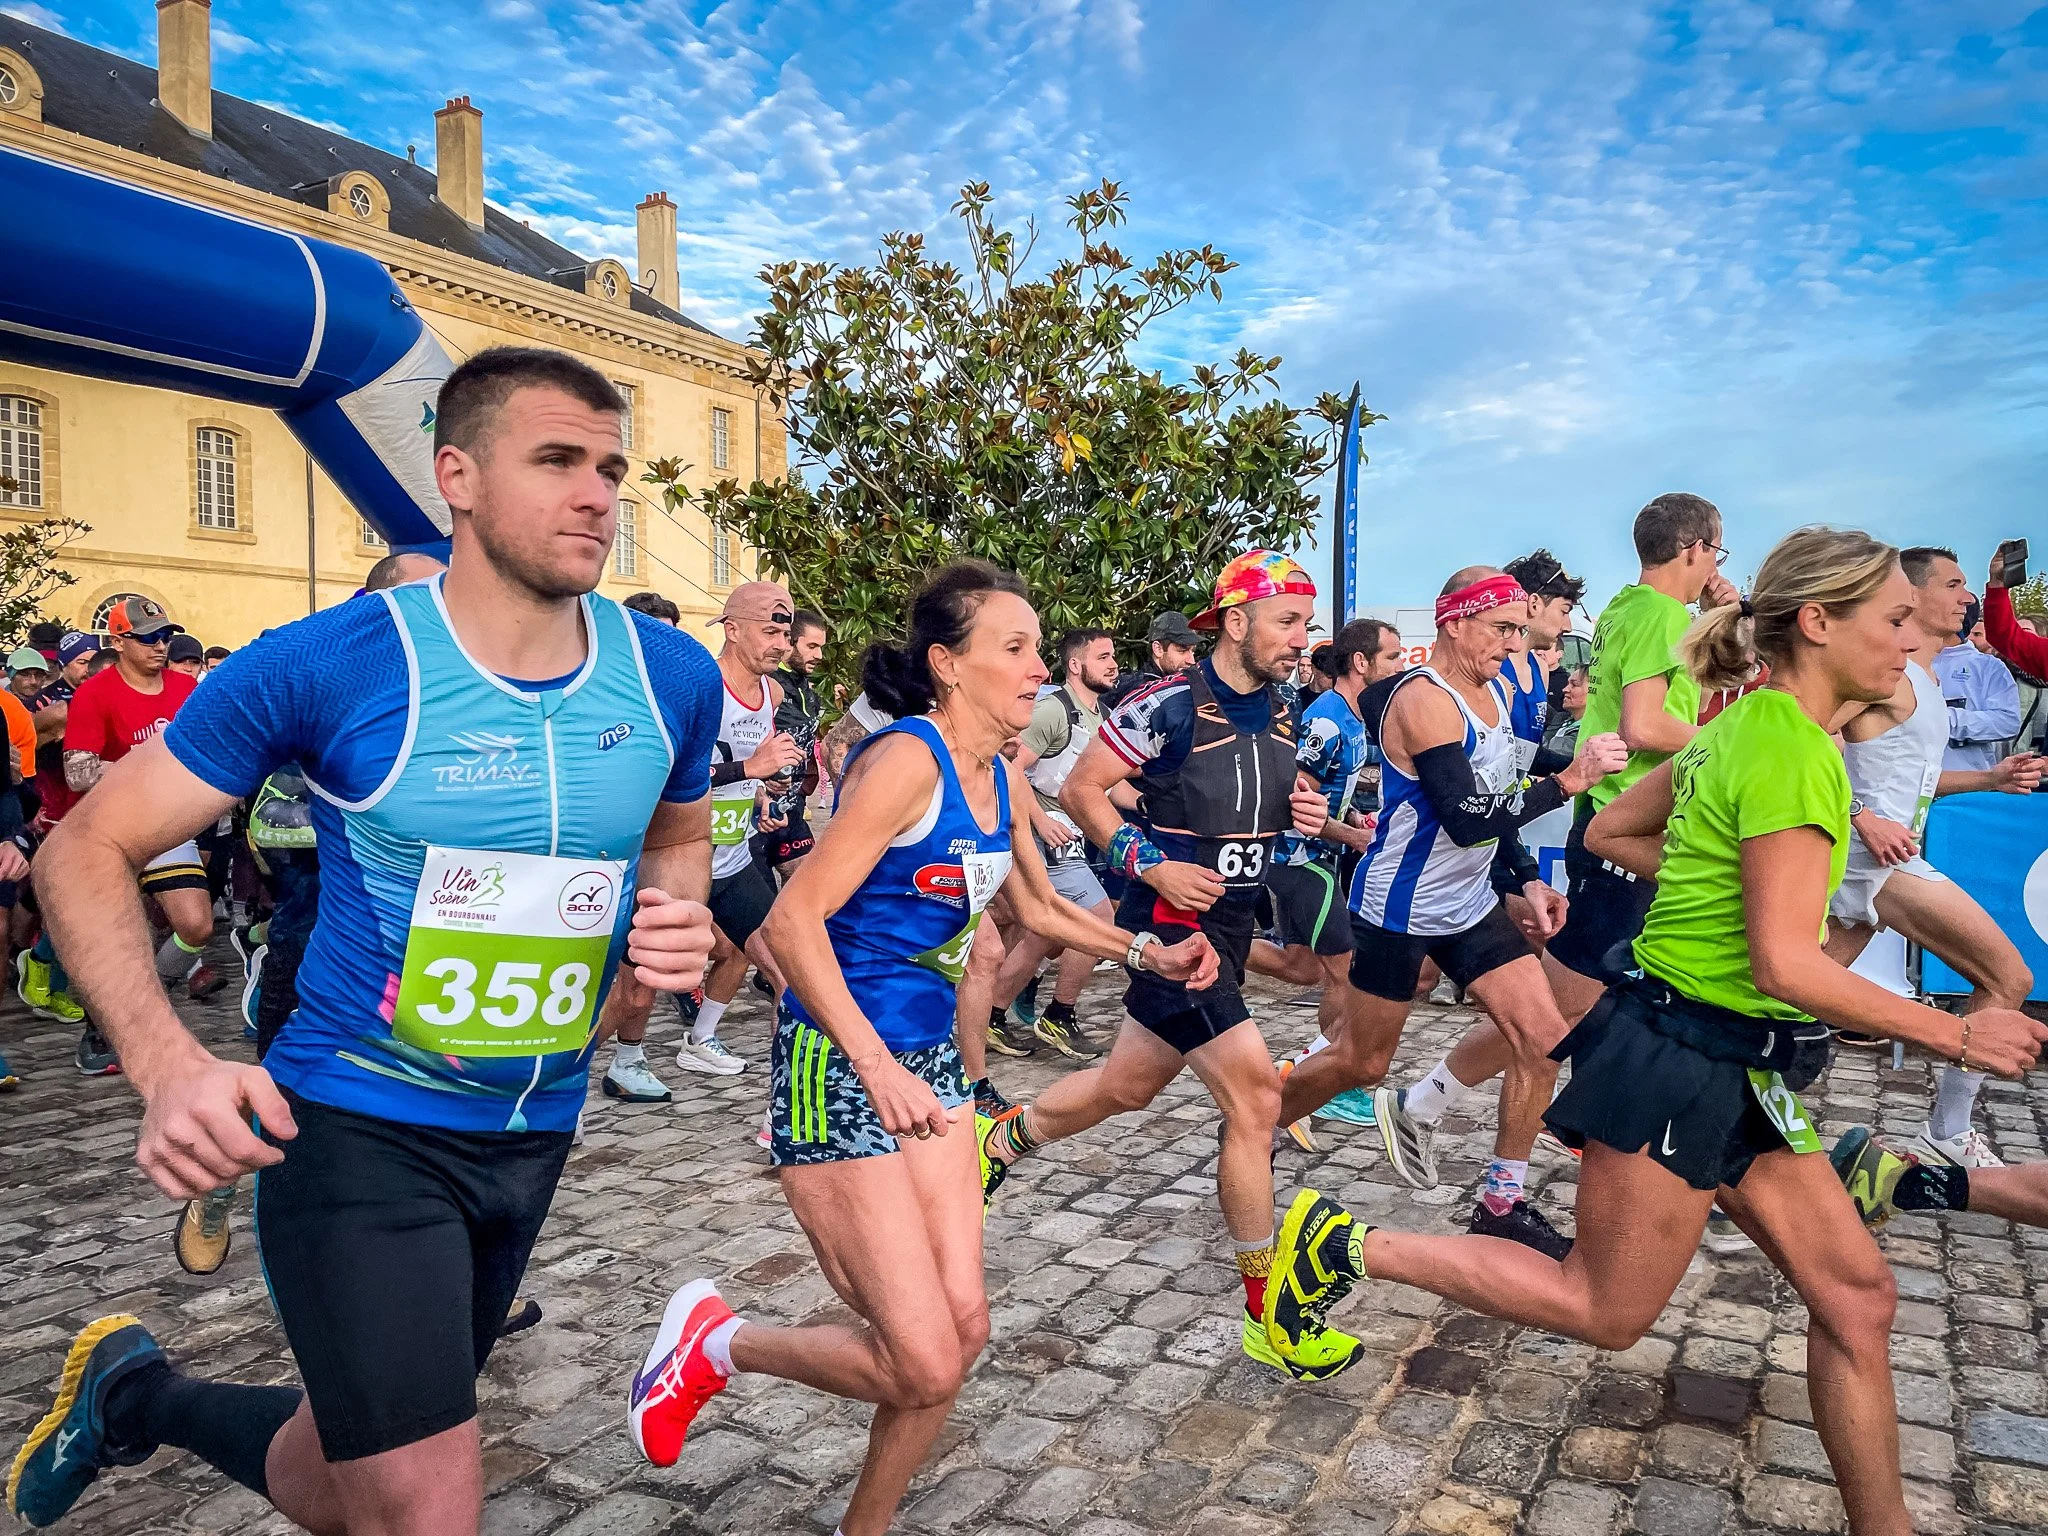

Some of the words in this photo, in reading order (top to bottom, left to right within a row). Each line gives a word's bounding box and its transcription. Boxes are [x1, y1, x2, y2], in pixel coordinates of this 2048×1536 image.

[742, 731, 762, 740] VICHY
[431, 763, 531, 784] TRIMAY
[711, 807, 750, 835] 234
[1217, 842, 1264, 878] 63
[437, 909, 447, 917] EN
[448, 910, 497, 922] BOURBONNAIS
[415, 957, 592, 1028] 358
